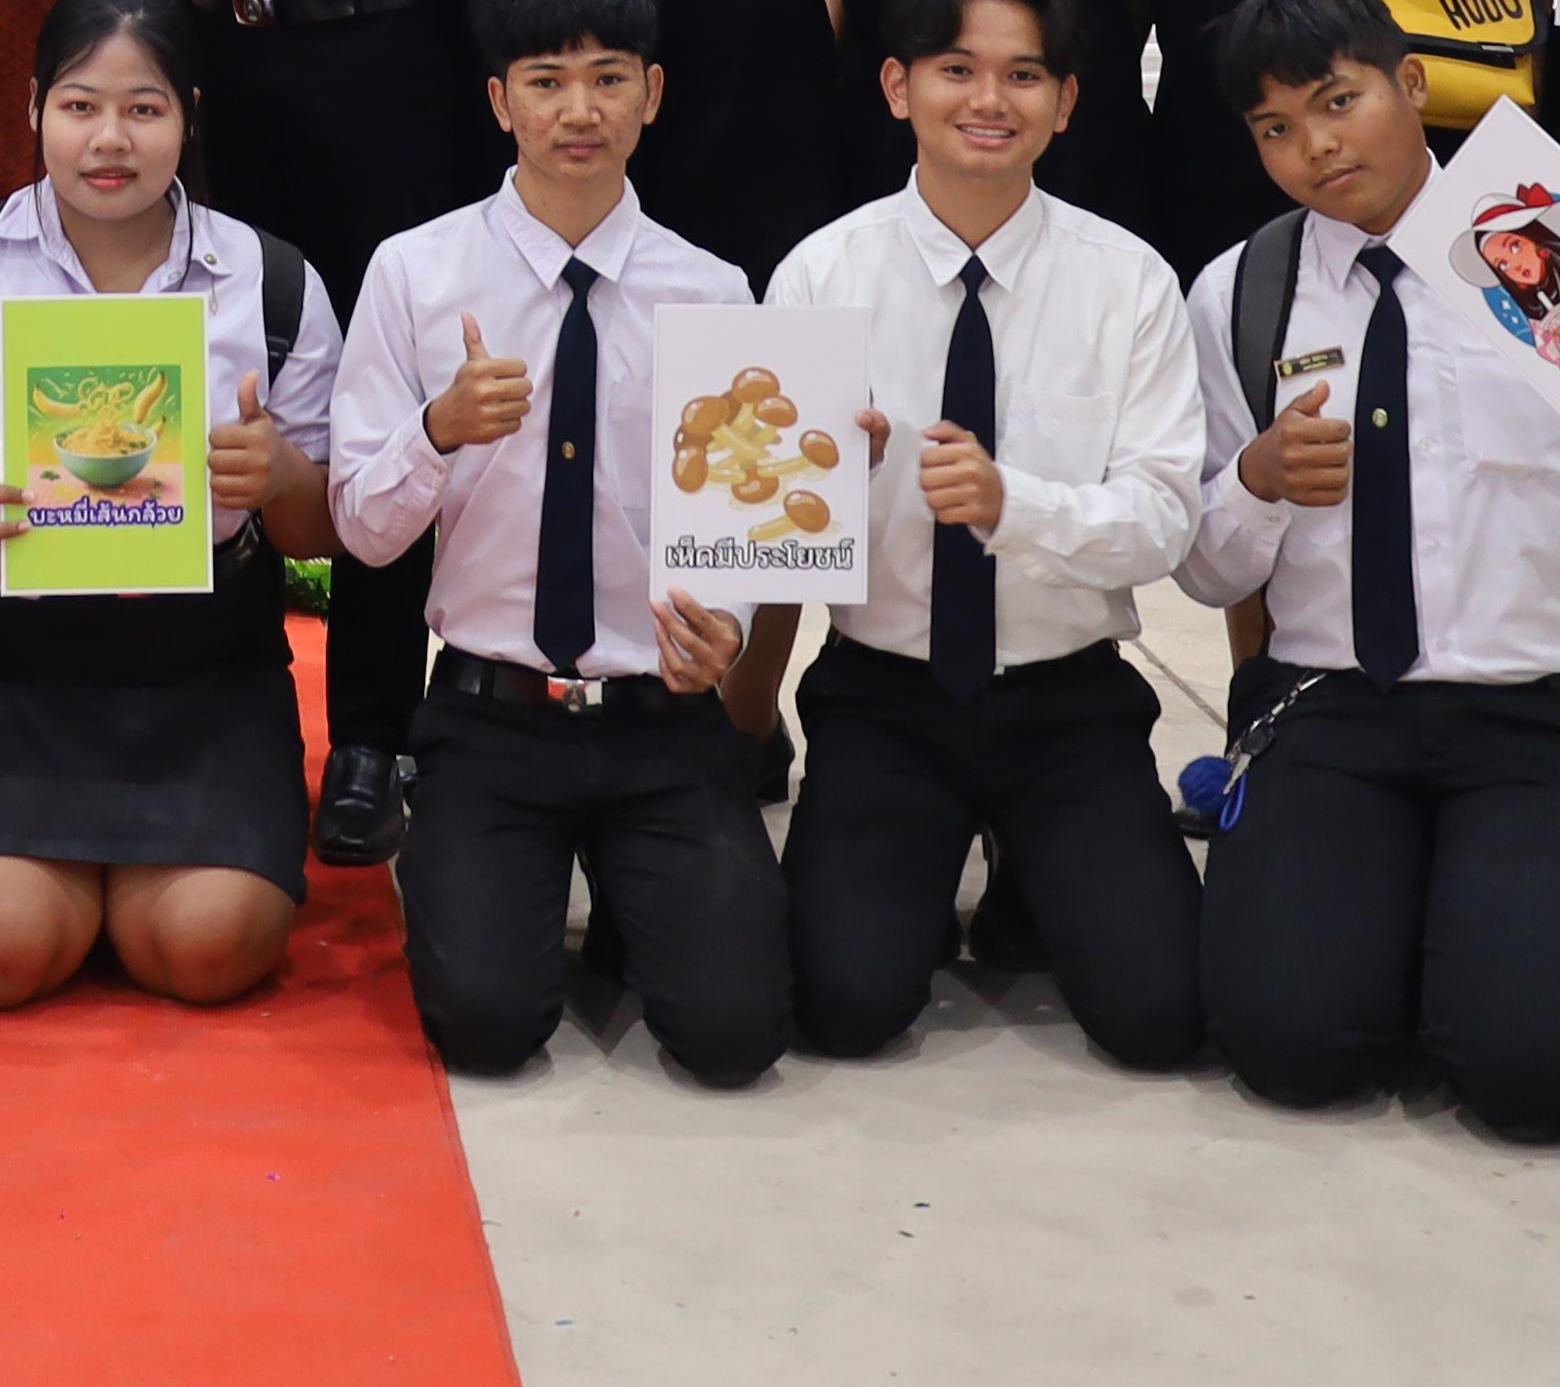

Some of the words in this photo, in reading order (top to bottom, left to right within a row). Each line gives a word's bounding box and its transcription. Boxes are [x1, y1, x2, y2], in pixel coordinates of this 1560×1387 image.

[28, 496, 184, 527] บะหมี่เส้นกล้วย
[665, 535, 855, 570] เห็ดมีประโยชน์
